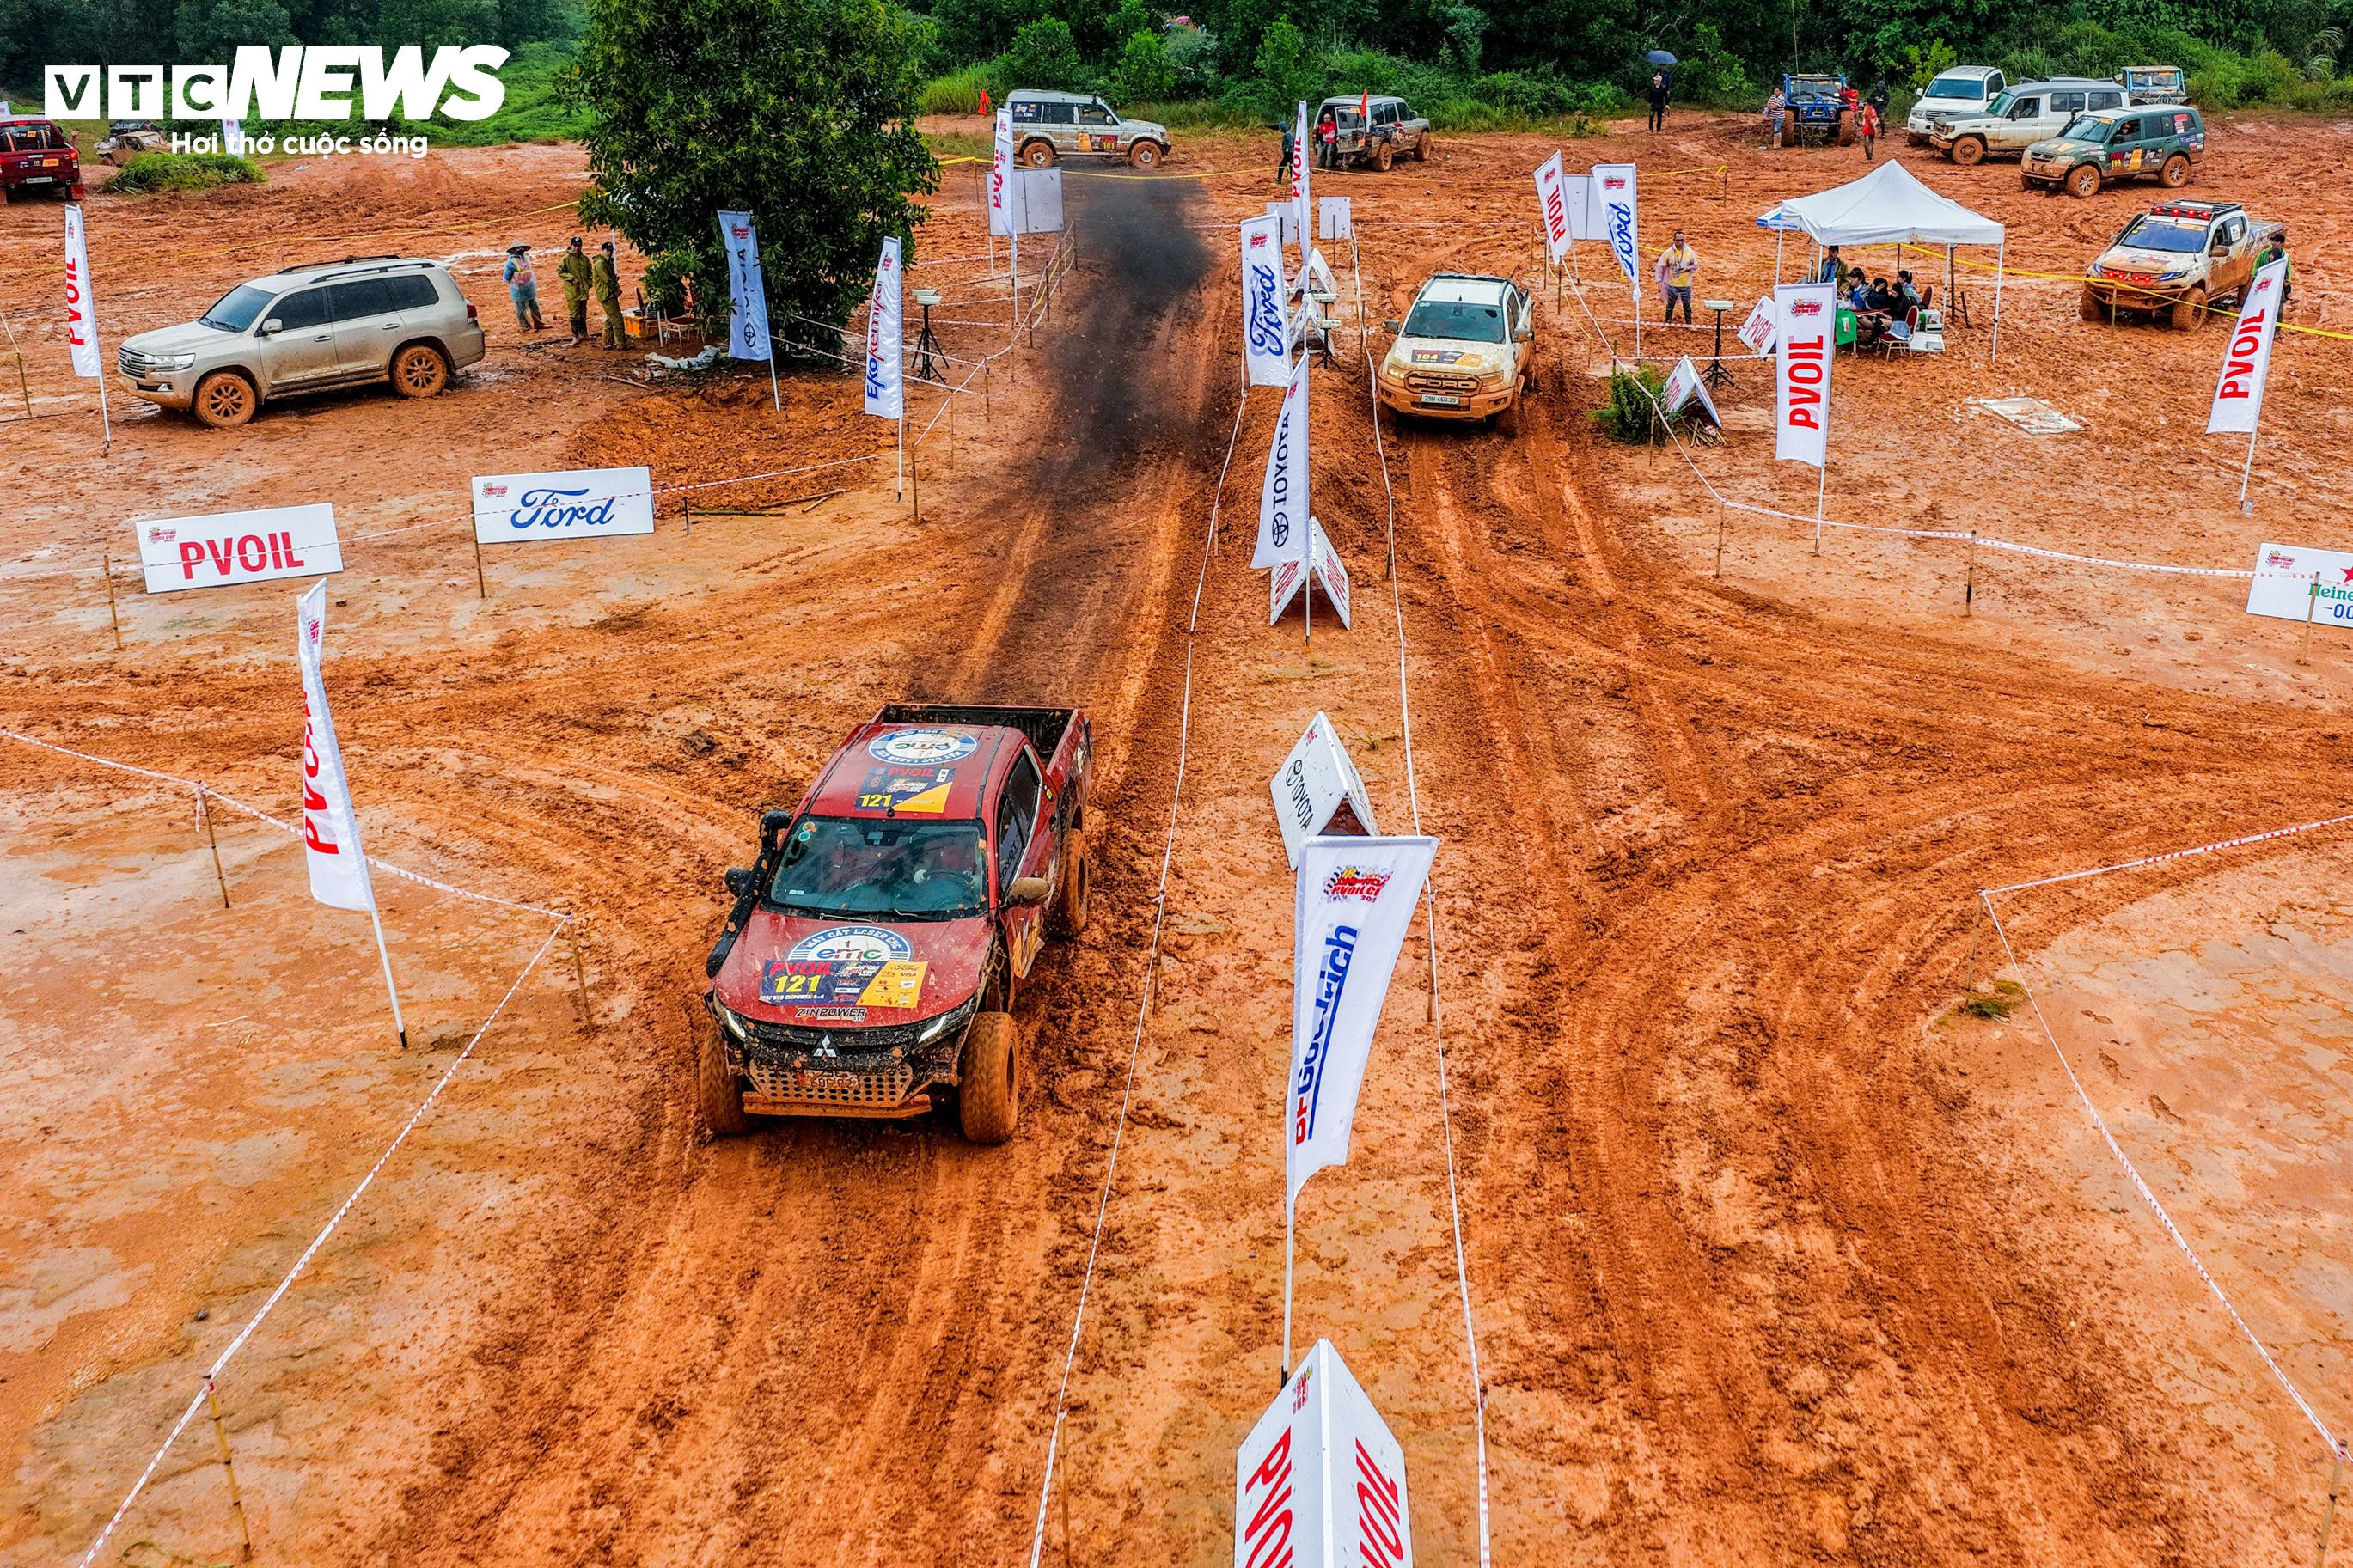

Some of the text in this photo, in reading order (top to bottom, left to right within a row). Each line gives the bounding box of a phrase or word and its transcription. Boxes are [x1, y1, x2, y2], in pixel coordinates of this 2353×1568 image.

[1547, 184, 1566, 245] PVOIL
[66, 257, 85, 345] PVOIL
[1249, 264, 1284, 357] Ford
[866, 280, 887, 400] Ekokemika
[2219, 308, 2265, 400] PVOIL
[1409, 378, 1479, 389] FORD
[1788, 335, 1824, 430] PVOIL
[510, 488, 617, 529] Ford
[180, 531, 305, 580] PVOIL
[886, 767, 934, 777] PVOIL
[860, 794, 892, 808] 121
[1291, 774, 1314, 831] TOYOTA
[769, 961, 834, 976] PVOIL
[816, 949, 883, 961] emc
[775, 974, 821, 993] 121
[796, 1007, 867, 1018] ZINPOWER
